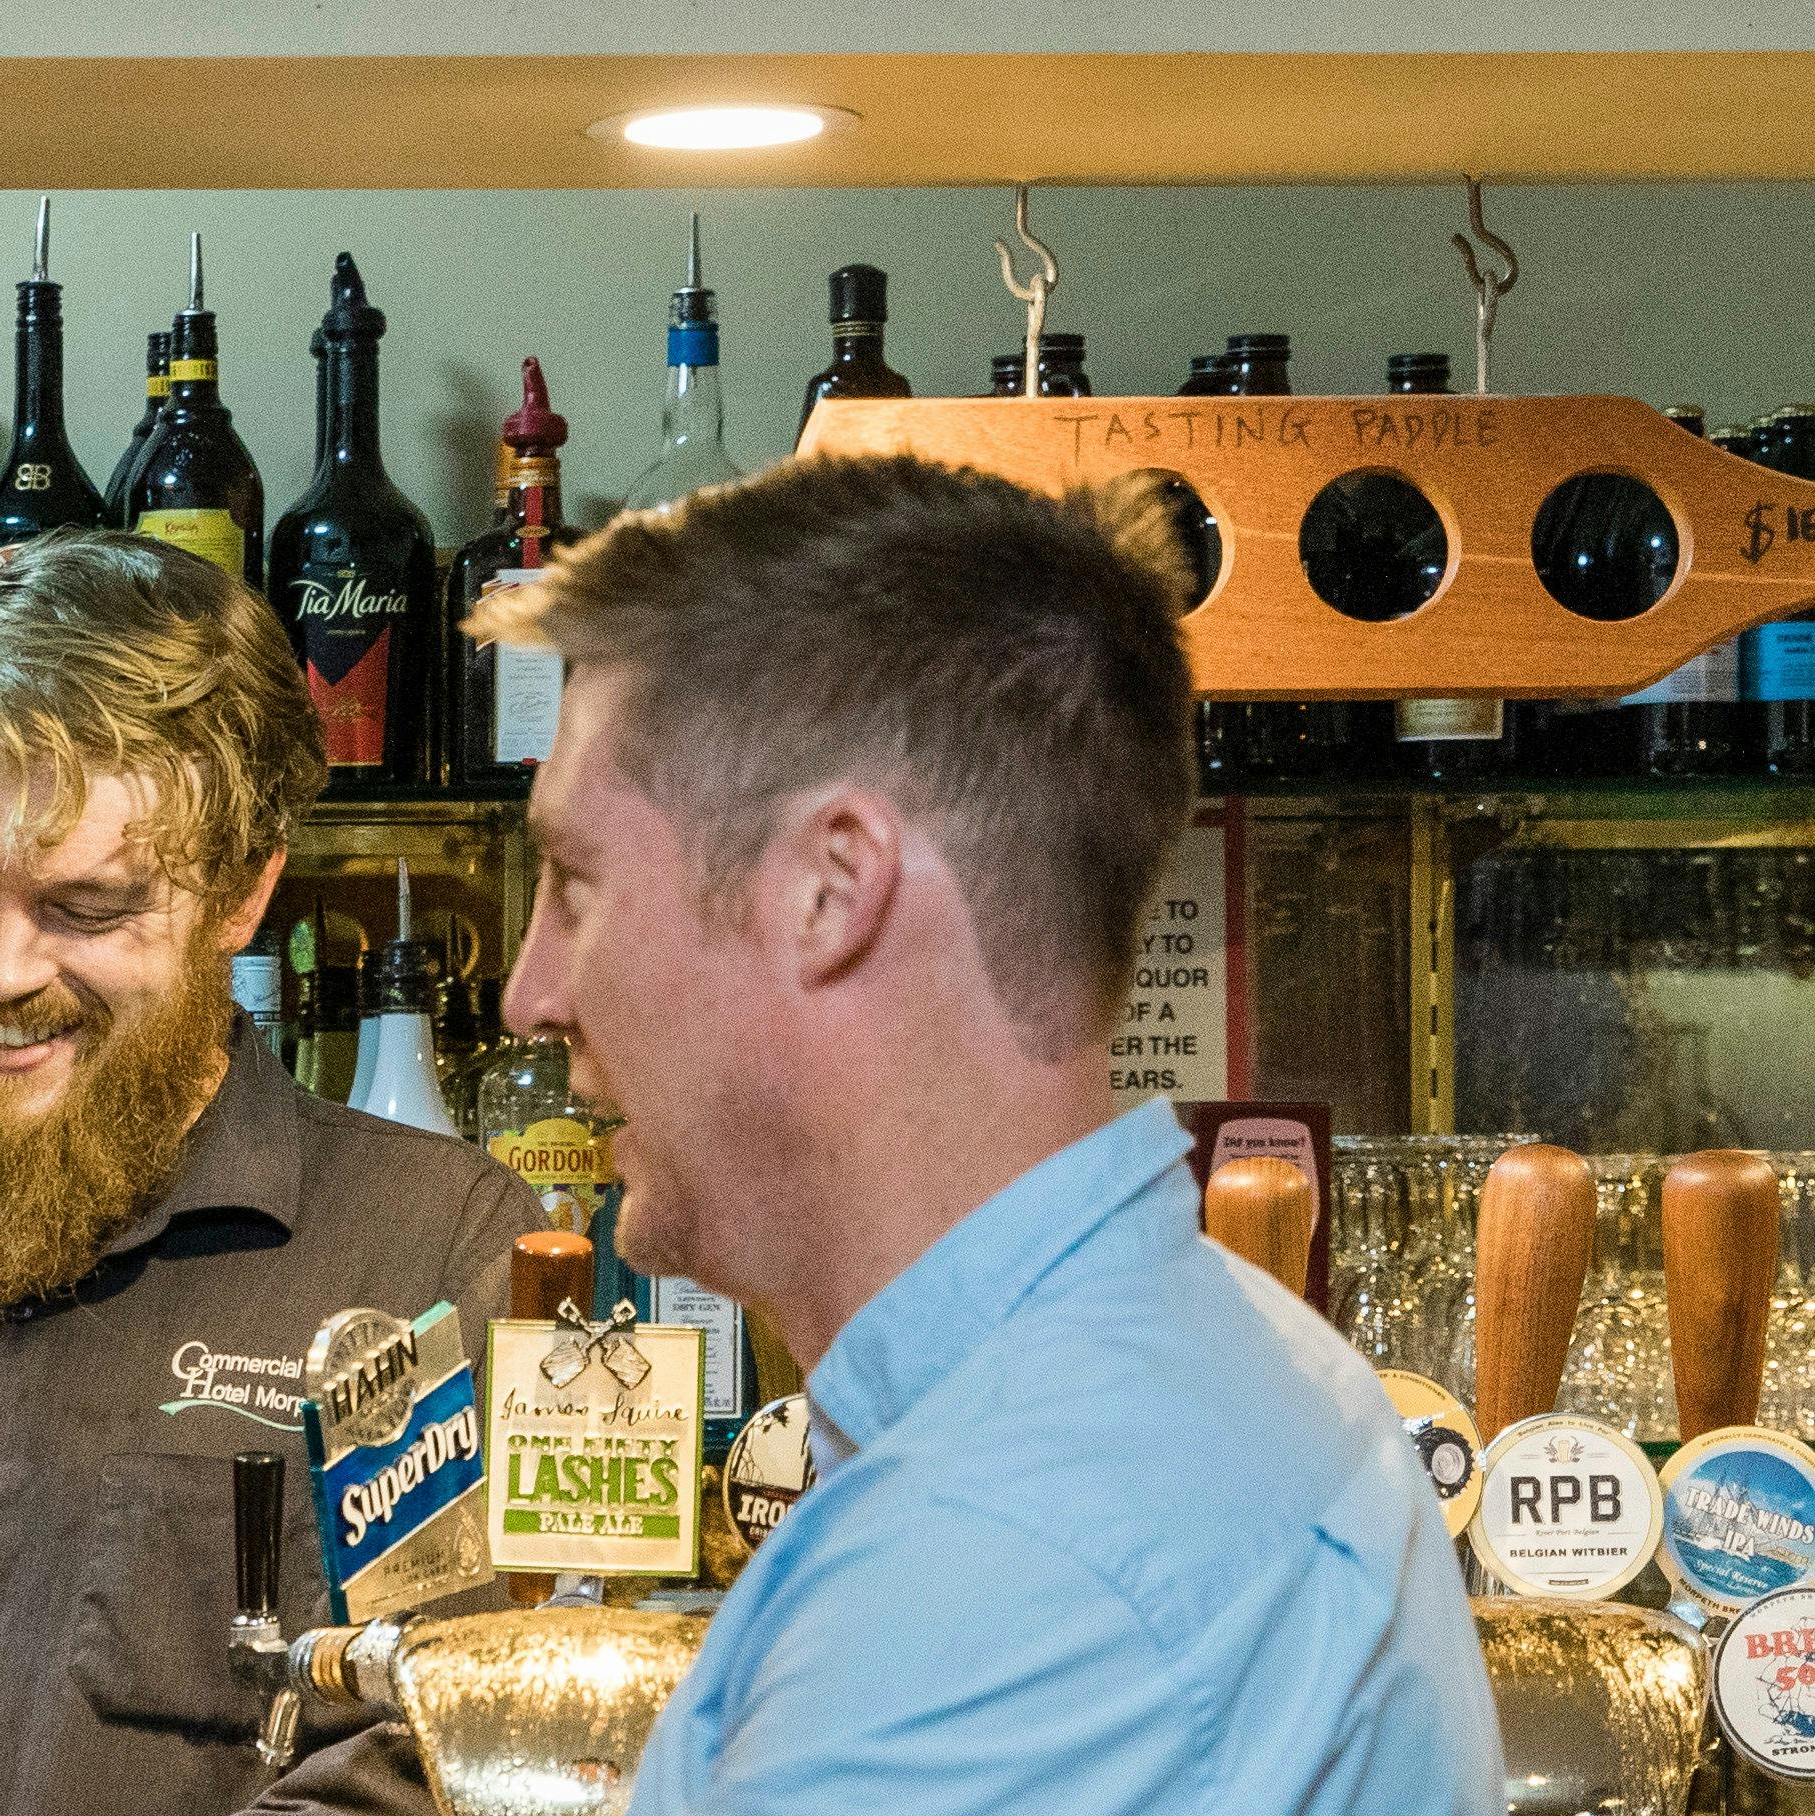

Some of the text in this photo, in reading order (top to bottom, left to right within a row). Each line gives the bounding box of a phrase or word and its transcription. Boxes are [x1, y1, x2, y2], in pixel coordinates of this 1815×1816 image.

[1054, 413, 1312, 465] TASTING
[289, 578, 407, 621] Tia Maria
[1169, 901, 1198, 920] TO
[1163, 934, 1193, 954] TO
[1135, 968, 1209, 988] QUOR
[1158, 1003, 1175, 1021] A
[1149, 1035, 1197, 1056] THE
[1110, 1070, 1183, 1090] EARS.
[171, 1341, 303, 1379] Commercial
[180, 1367, 305, 1416] Hotel Morp
[330, 1331, 419, 1425] HAHN
[508, 1435, 679, 1456] ONE FIFTY
[342, 1406, 478, 1546] SuperDry
[508, 1453, 678, 1506] LASHES
[738, 1494, 790, 1525] IRO
[1511, 1475, 1621, 1523] RPB
[539, 1512, 643, 1534] PALE ALE
[1685, 1486, 1815, 1544] TRADE WINDS
[1510, 1547, 1627, 1558] BELGIAN WITBIER
[1723, 1529, 1755, 1558] IPA
